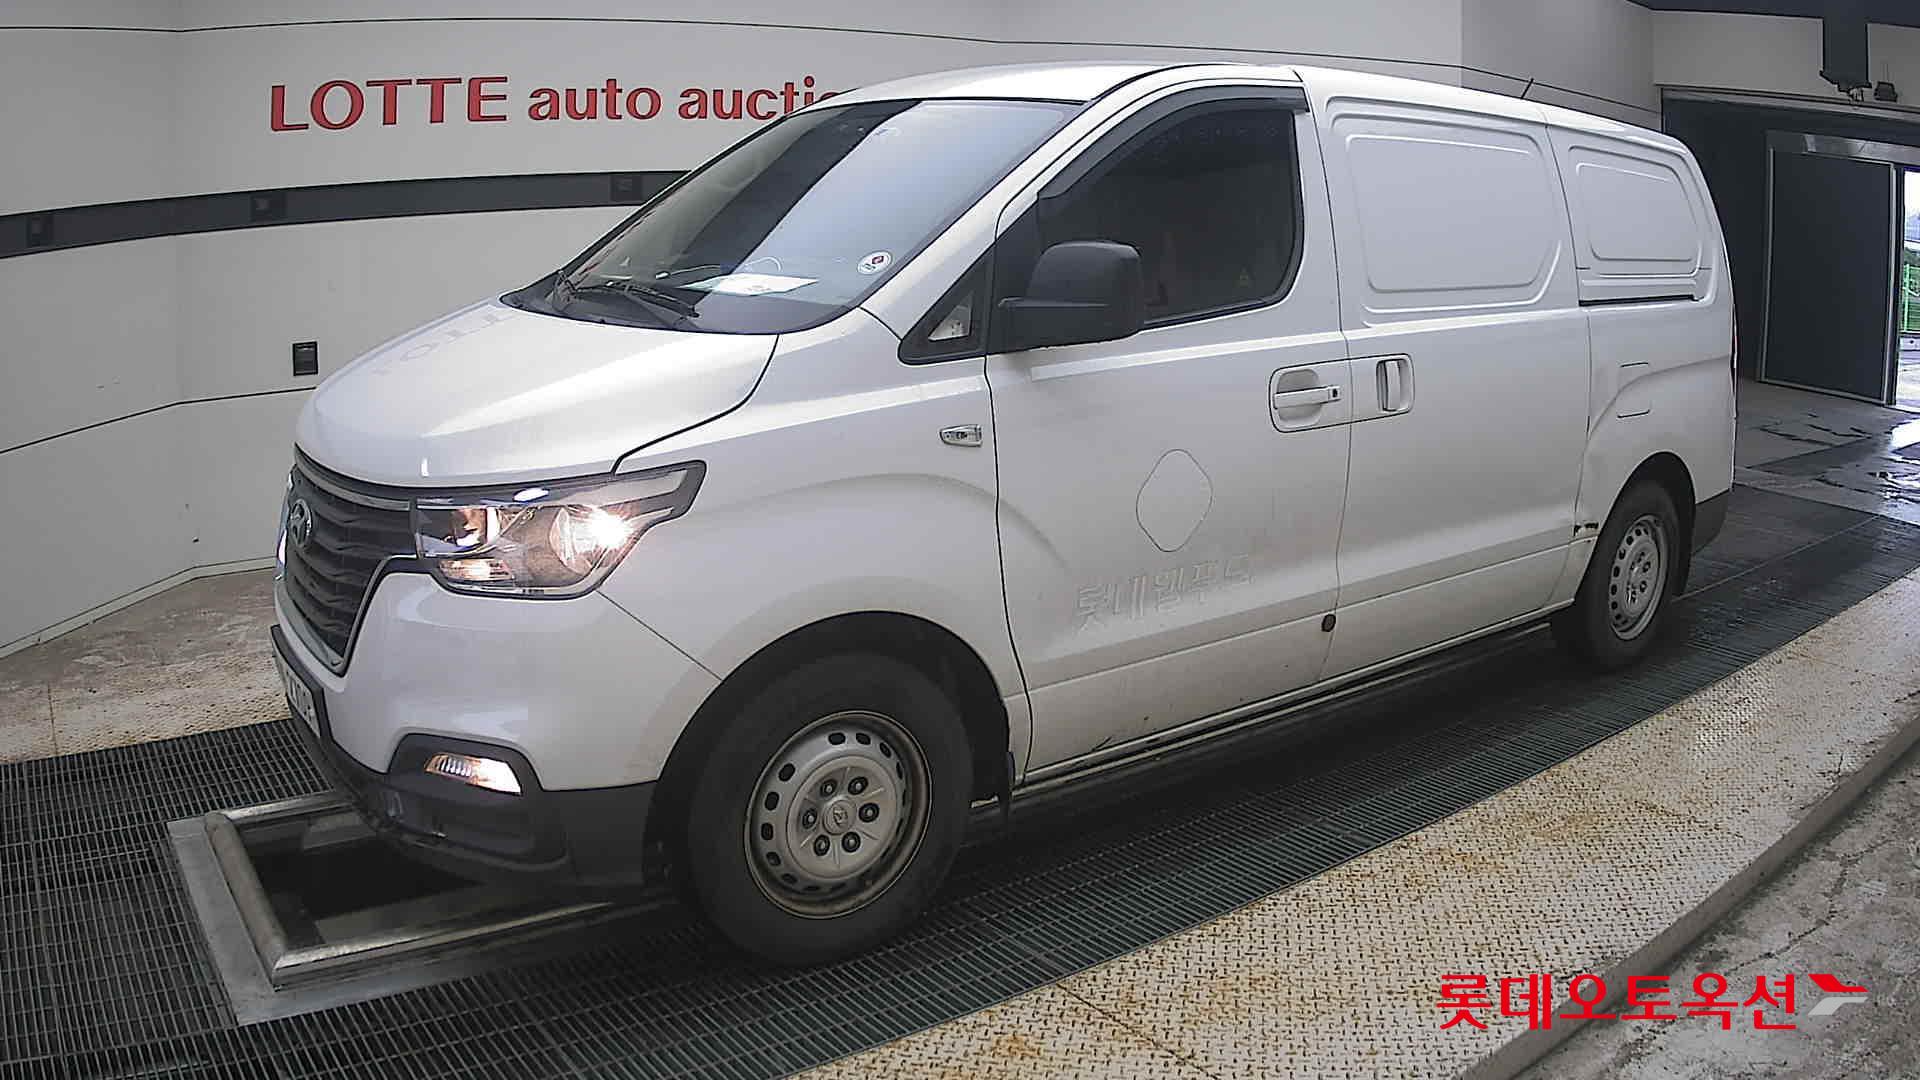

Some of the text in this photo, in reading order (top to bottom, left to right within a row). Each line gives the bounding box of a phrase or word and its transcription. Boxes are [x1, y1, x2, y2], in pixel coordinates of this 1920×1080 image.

[270, 76, 840, 132] LOTTE auto aucti
